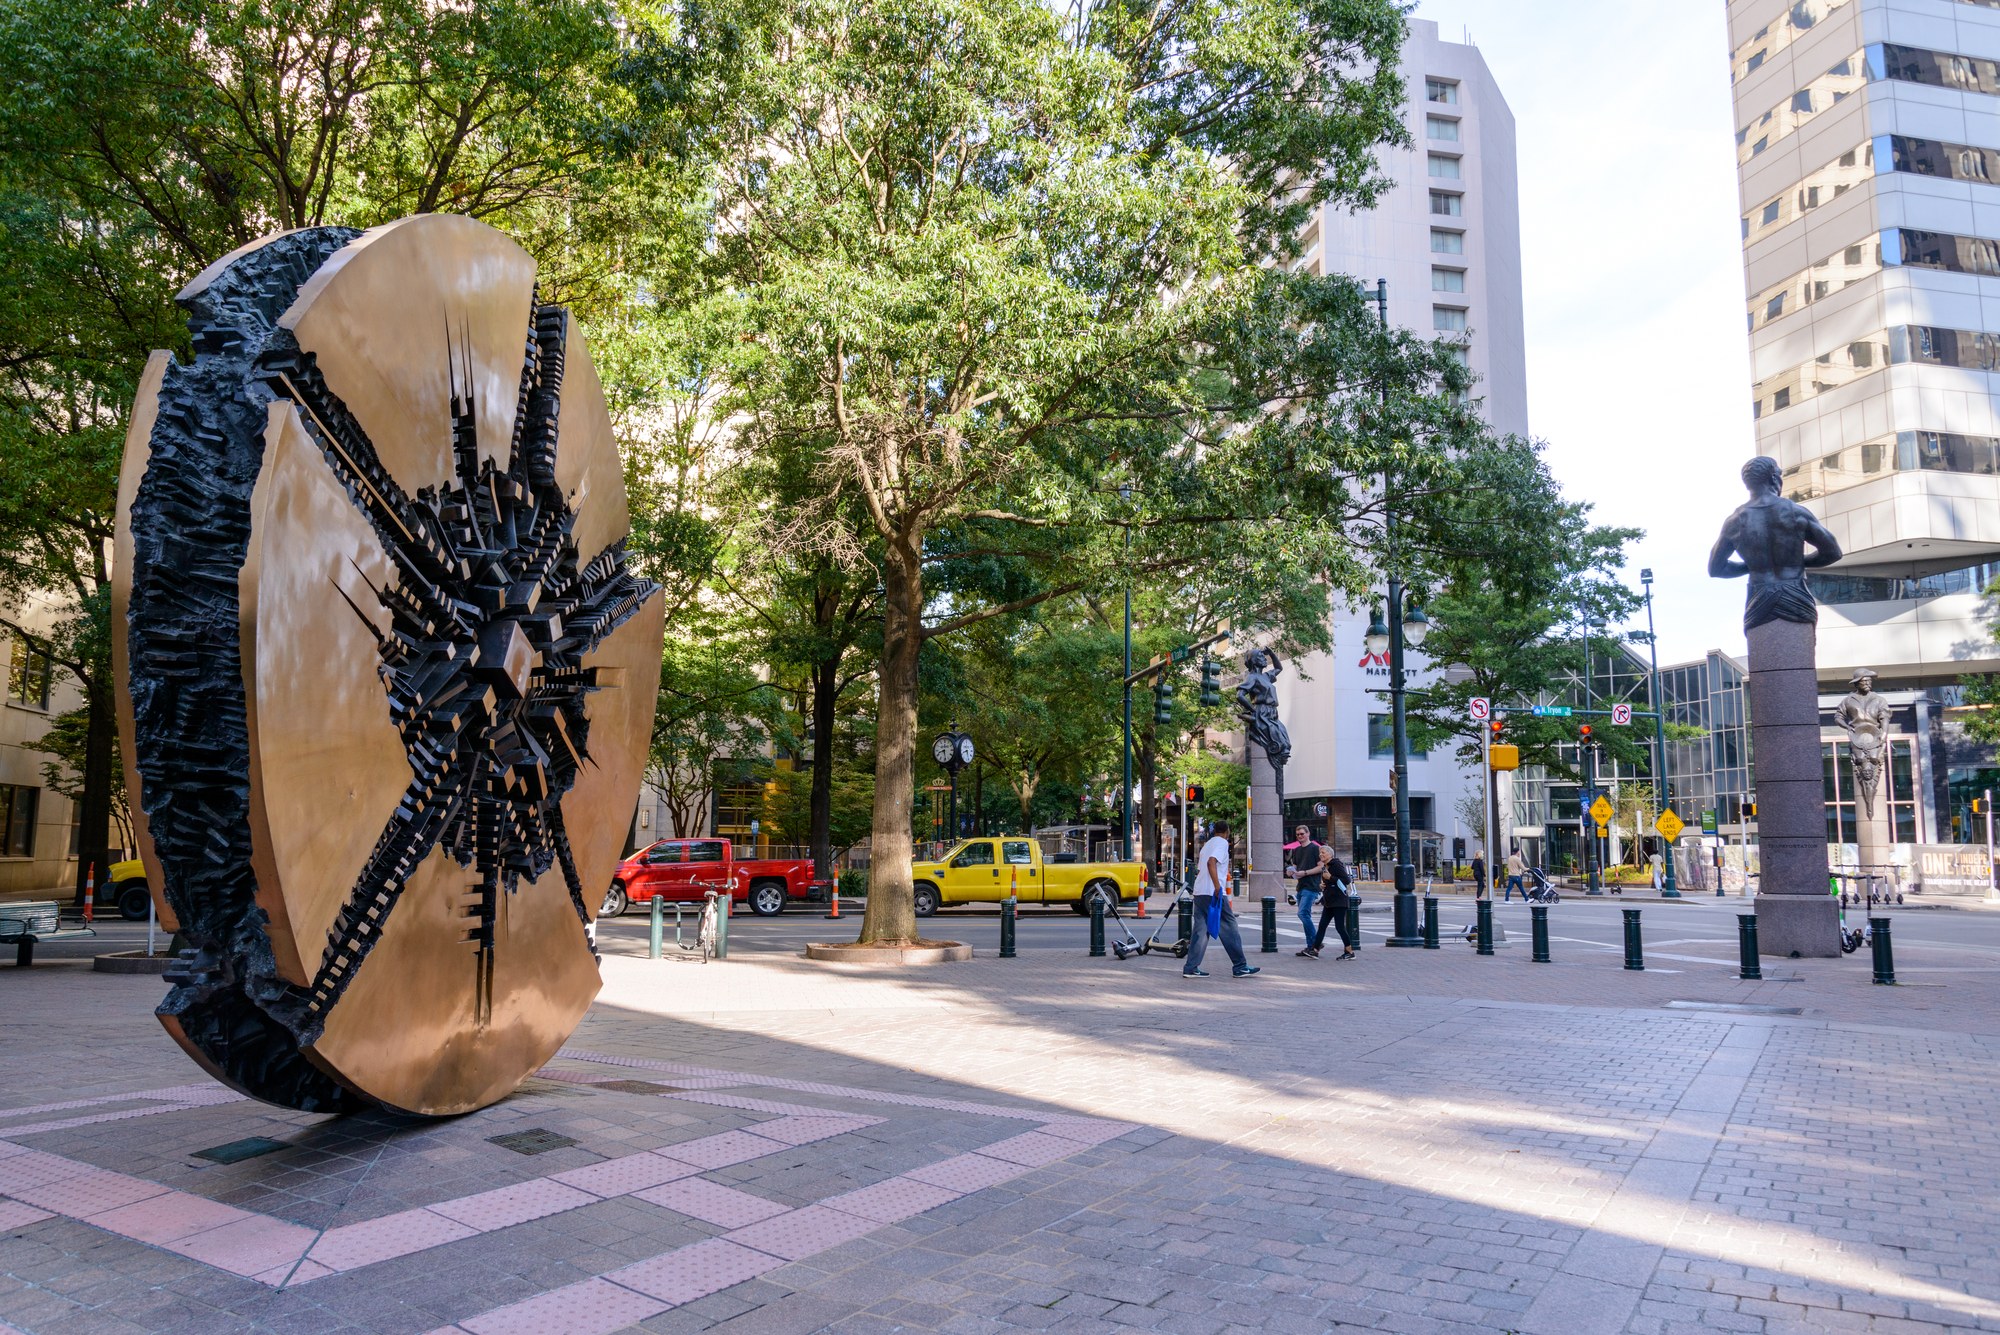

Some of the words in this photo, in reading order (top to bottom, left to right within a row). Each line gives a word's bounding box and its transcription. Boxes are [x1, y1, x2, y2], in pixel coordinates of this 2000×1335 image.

[1547, 706, 1562, 716] Tryon
[1922, 852, 1954, 875] ONE
[1973, 879, 1990, 887] HEART
